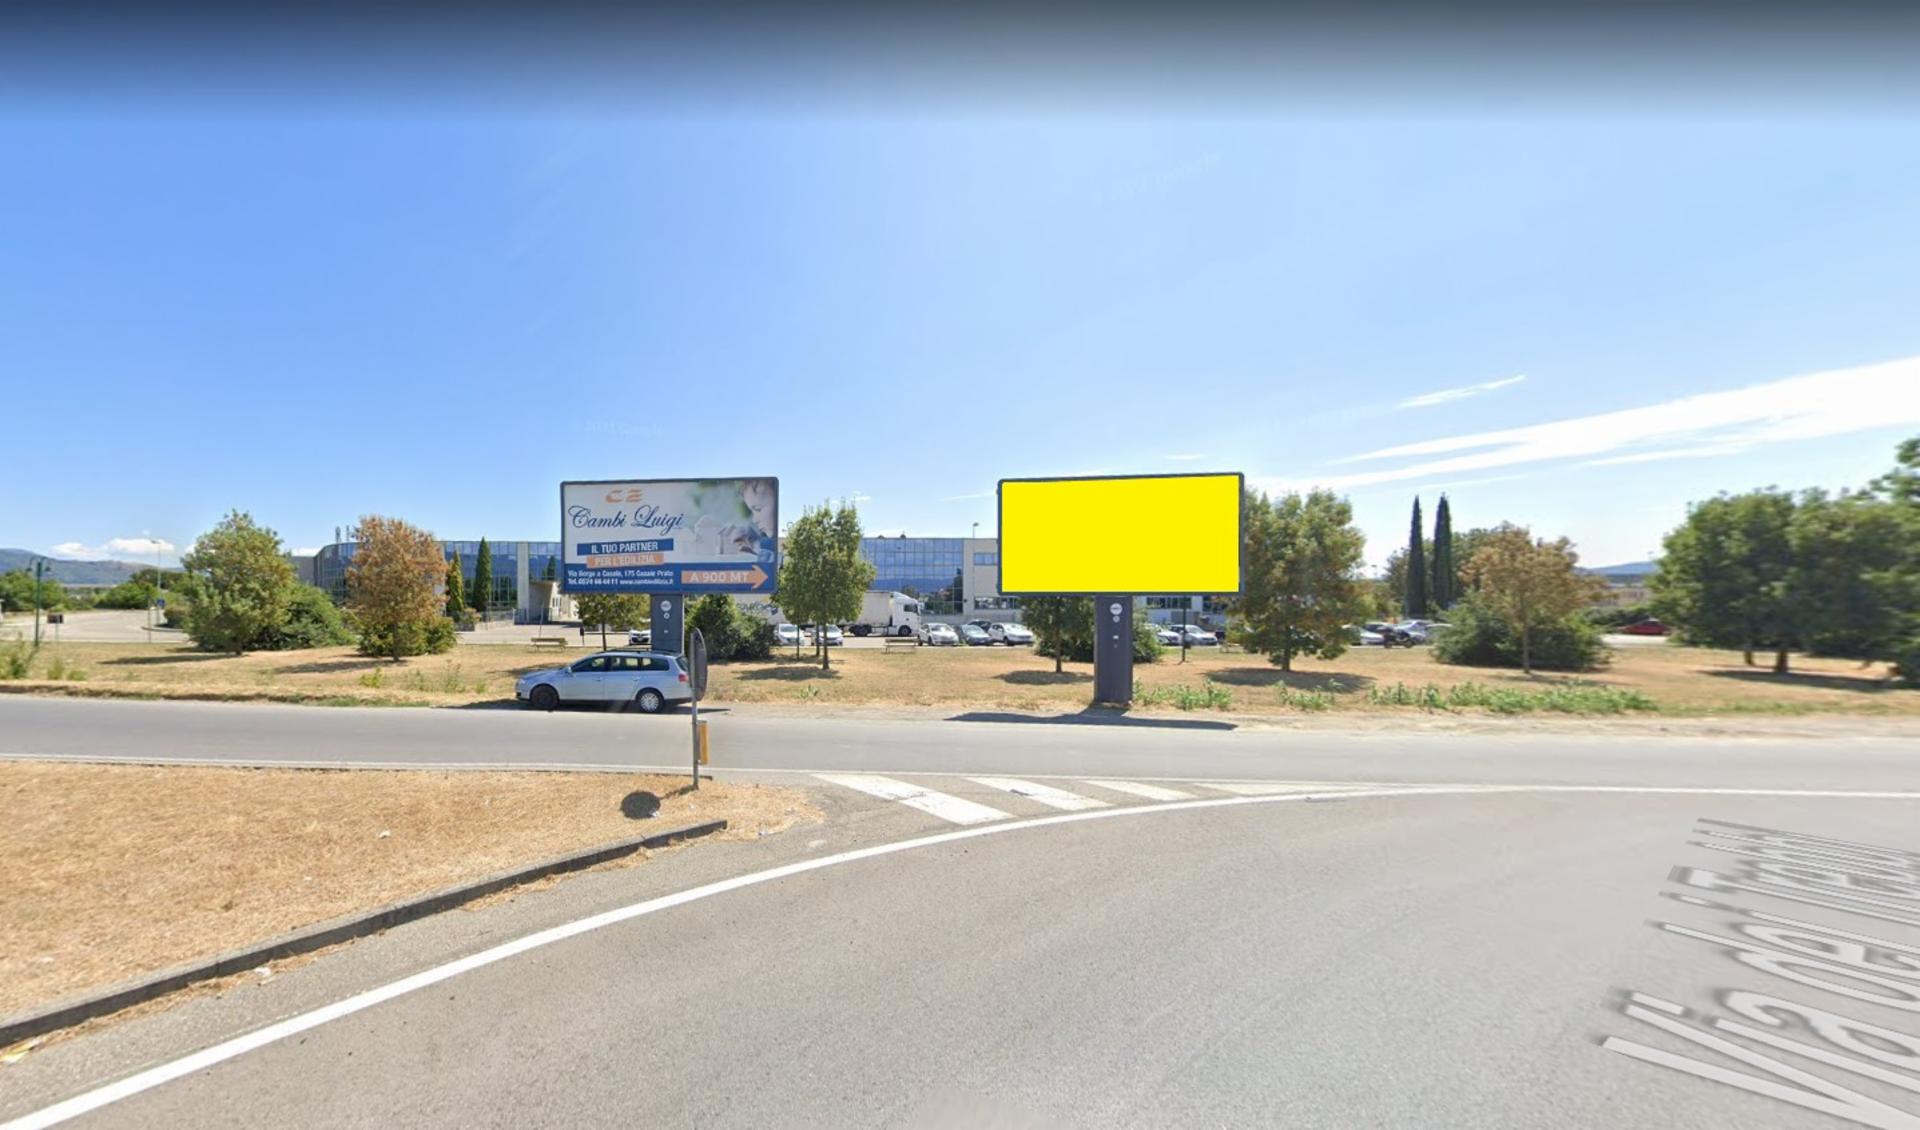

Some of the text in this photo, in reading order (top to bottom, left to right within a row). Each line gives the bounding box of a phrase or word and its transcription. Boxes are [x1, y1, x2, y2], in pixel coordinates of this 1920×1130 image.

[568, 504, 685, 536] Cambi Luigi
[591, 541, 658, 554] IL TUO PARTNER
[597, 556, 612, 566] PER
[690, 572, 749, 583] A 900 MT
